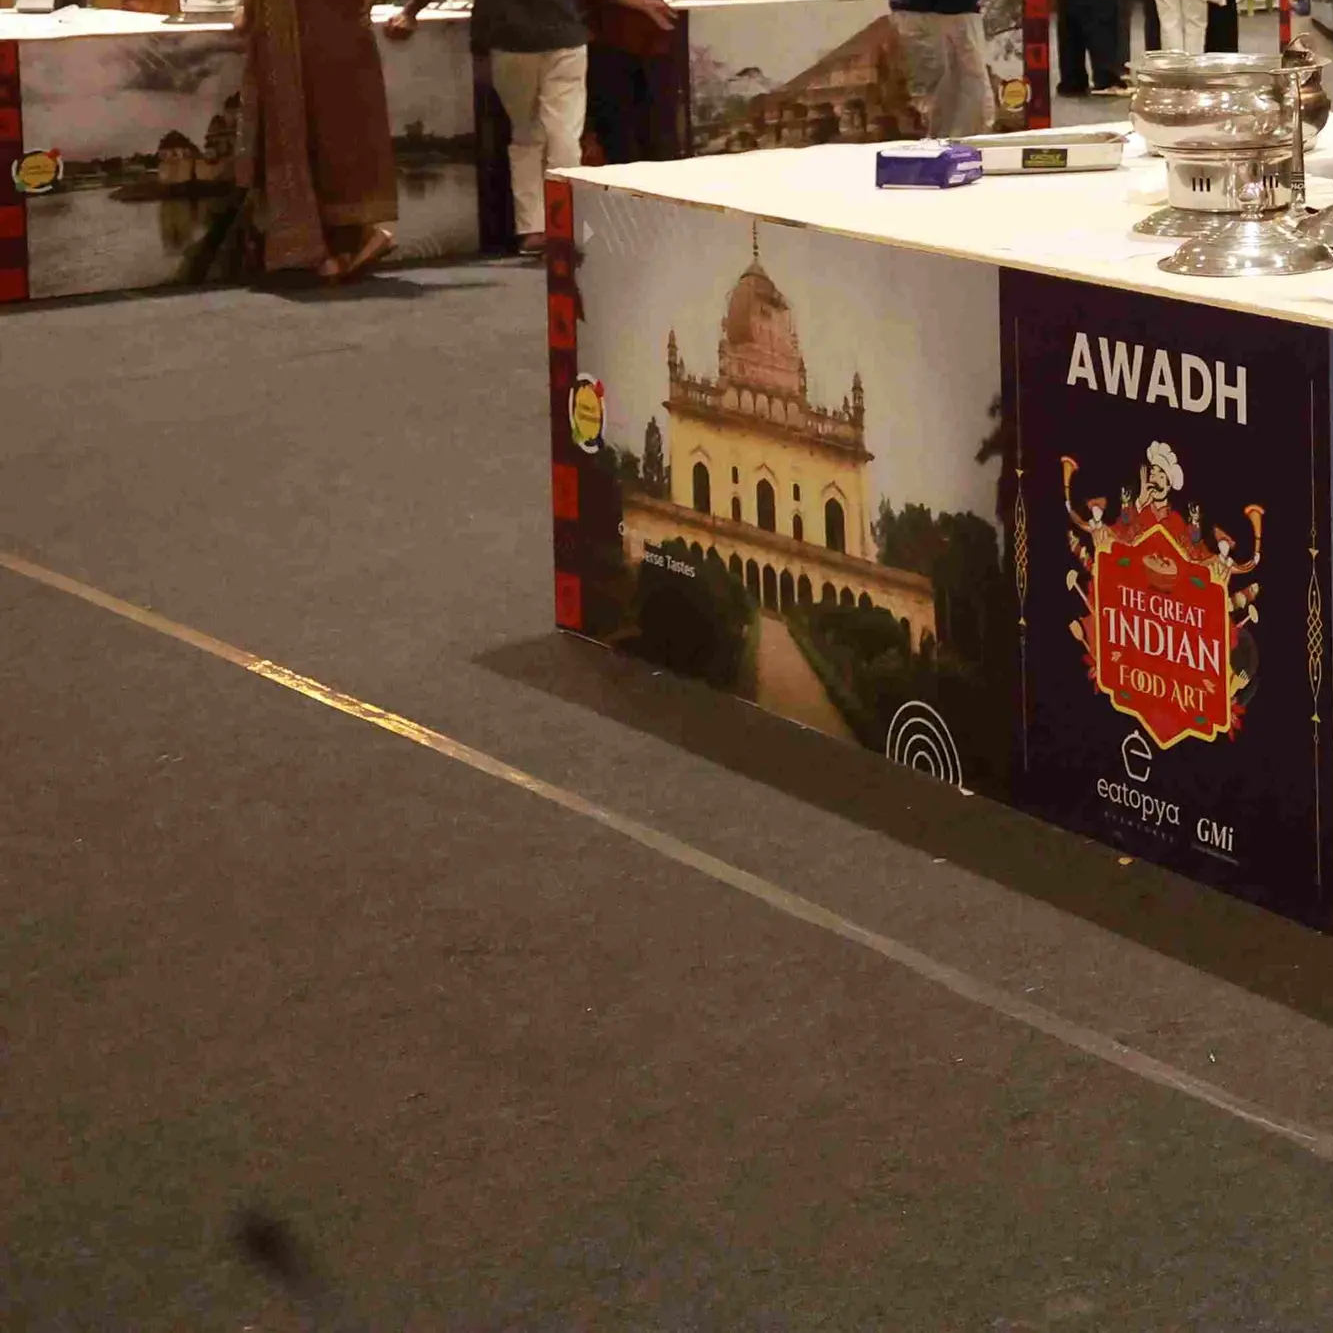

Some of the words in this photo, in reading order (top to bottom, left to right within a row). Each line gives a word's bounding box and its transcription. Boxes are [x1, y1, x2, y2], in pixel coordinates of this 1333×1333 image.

[1067, 332, 1248, 425] AWADH
[665, 554, 696, 578] Tastes
[1118, 585, 1146, 612] THE
[1149, 595, 1205, 628] GREAT
[1103, 606, 1220, 677] INDIAN
[1119, 664, 1166, 698] FOOD
[1170, 679, 1207, 713] ART
[1096, 777, 1180, 826] eatopya
[1196, 817, 1234, 852] GMi
